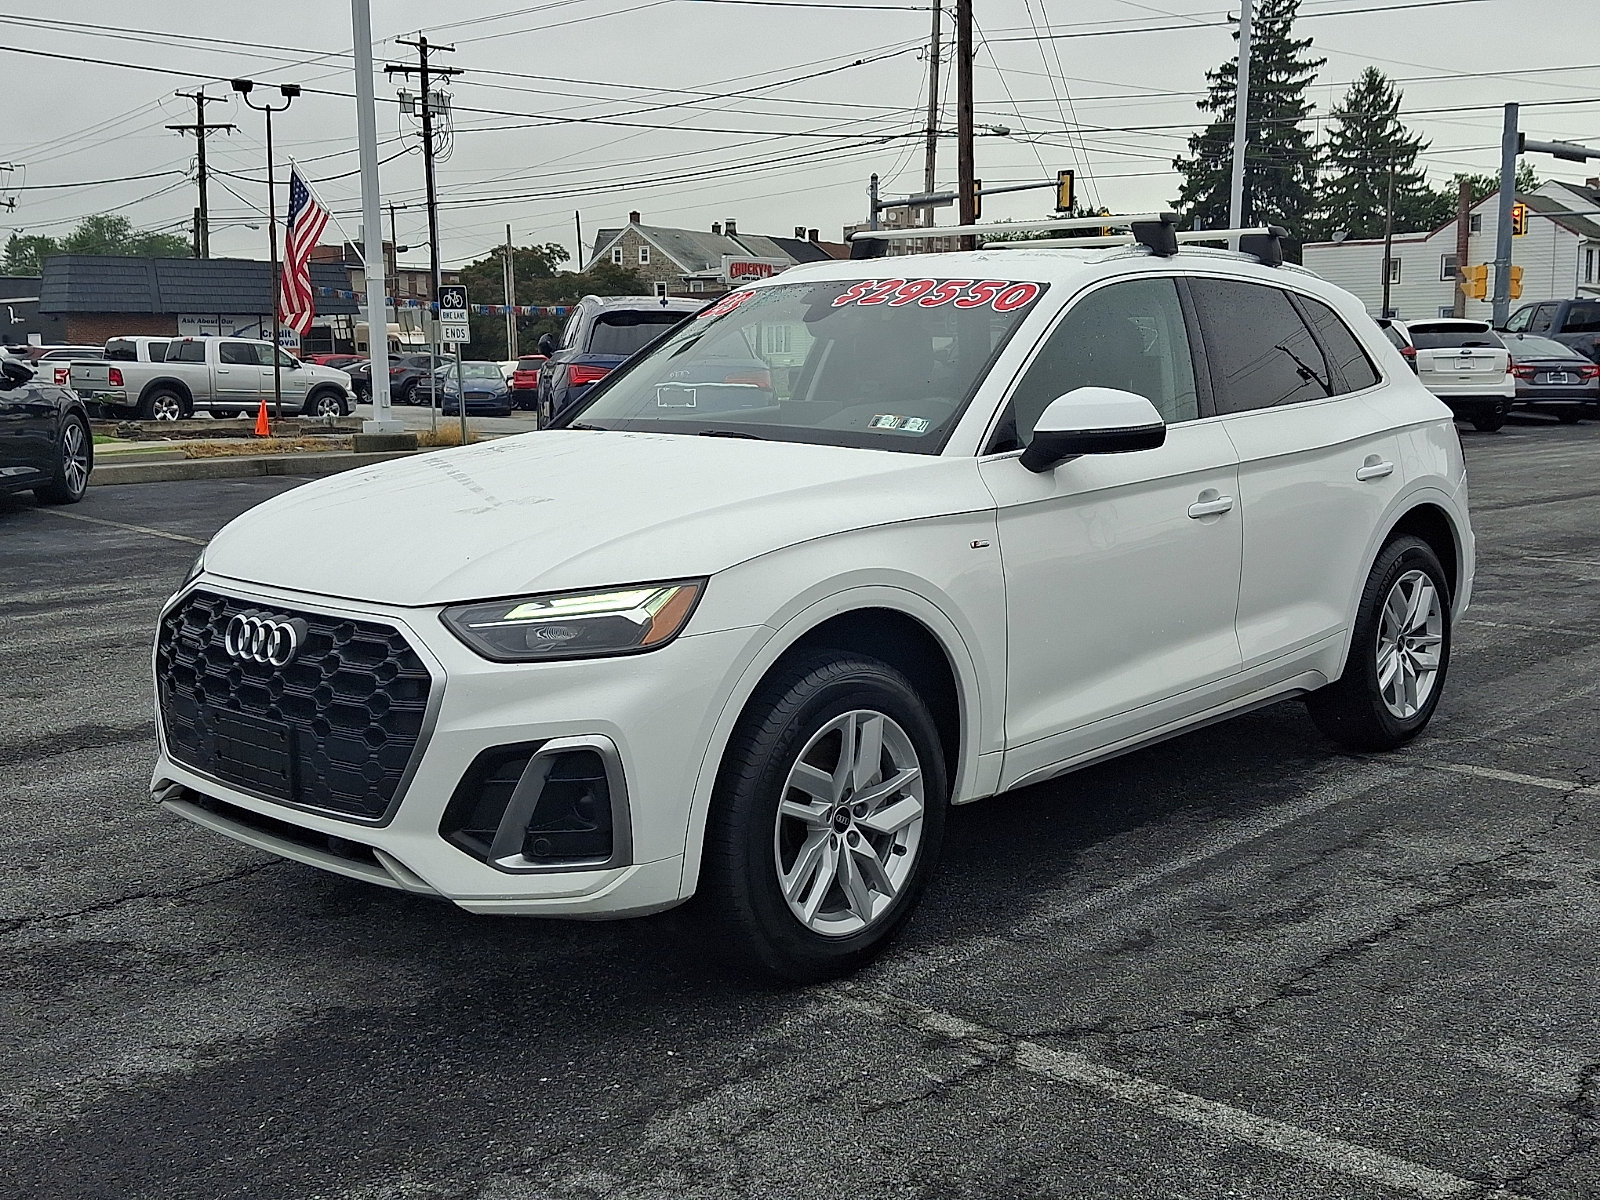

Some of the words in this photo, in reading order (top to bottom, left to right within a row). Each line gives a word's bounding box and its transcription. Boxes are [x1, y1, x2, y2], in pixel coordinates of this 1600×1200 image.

[831, 278, 1040, 312] $29550
[442, 311, 453, 319] BIKE
[262, 329, 292, 338] Crdit
[445, 328, 466, 338] ENDS
